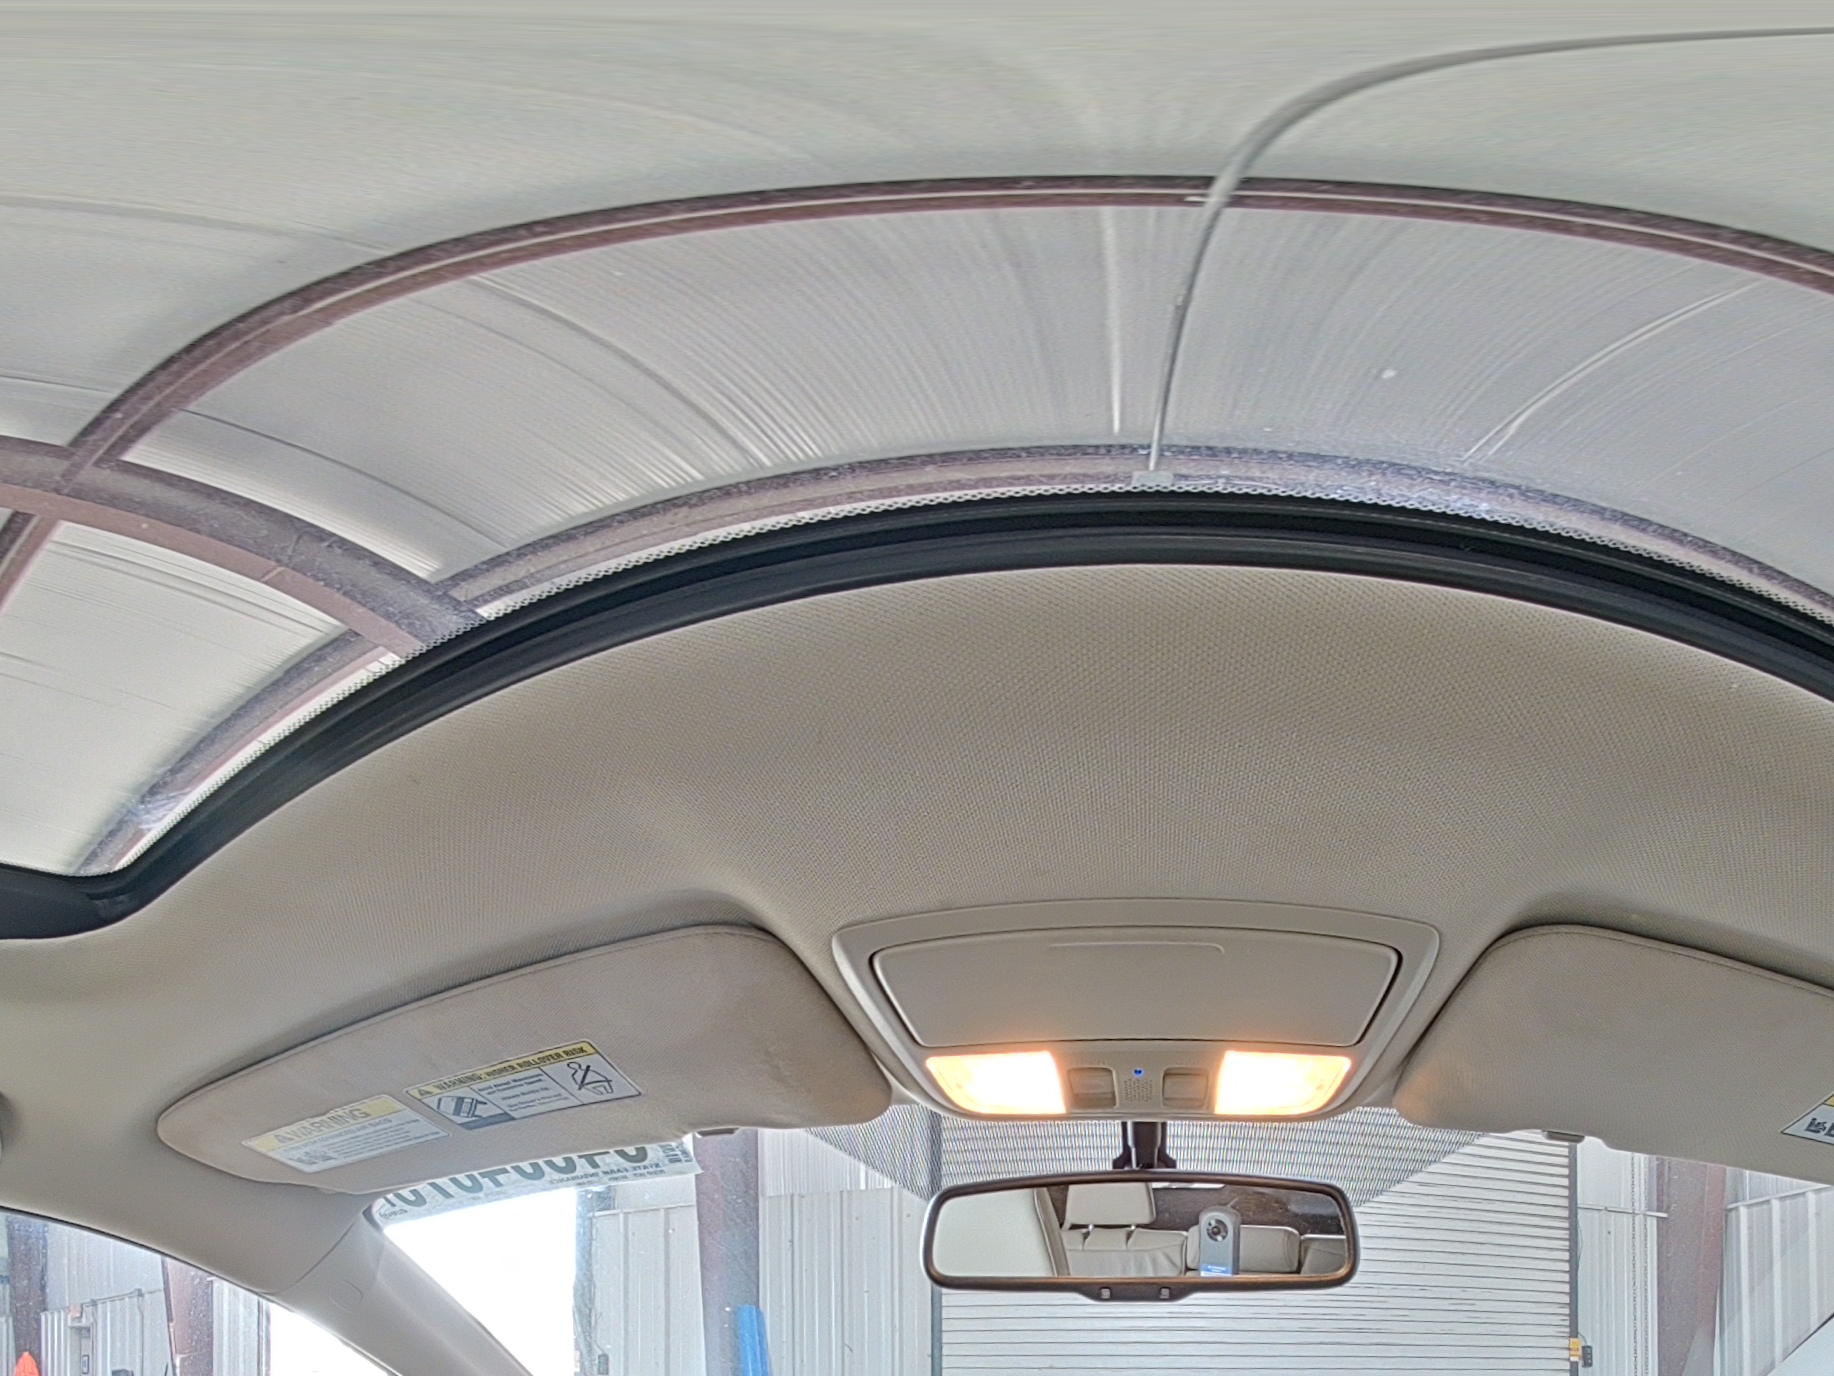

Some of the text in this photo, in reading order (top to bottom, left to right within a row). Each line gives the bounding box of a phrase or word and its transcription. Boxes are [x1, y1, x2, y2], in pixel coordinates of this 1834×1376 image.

[517, 1053, 563, 1069] ROLLOVER
[562, 1046, 587, 1058] RISK
[287, 1108, 370, 1140] WARNING
